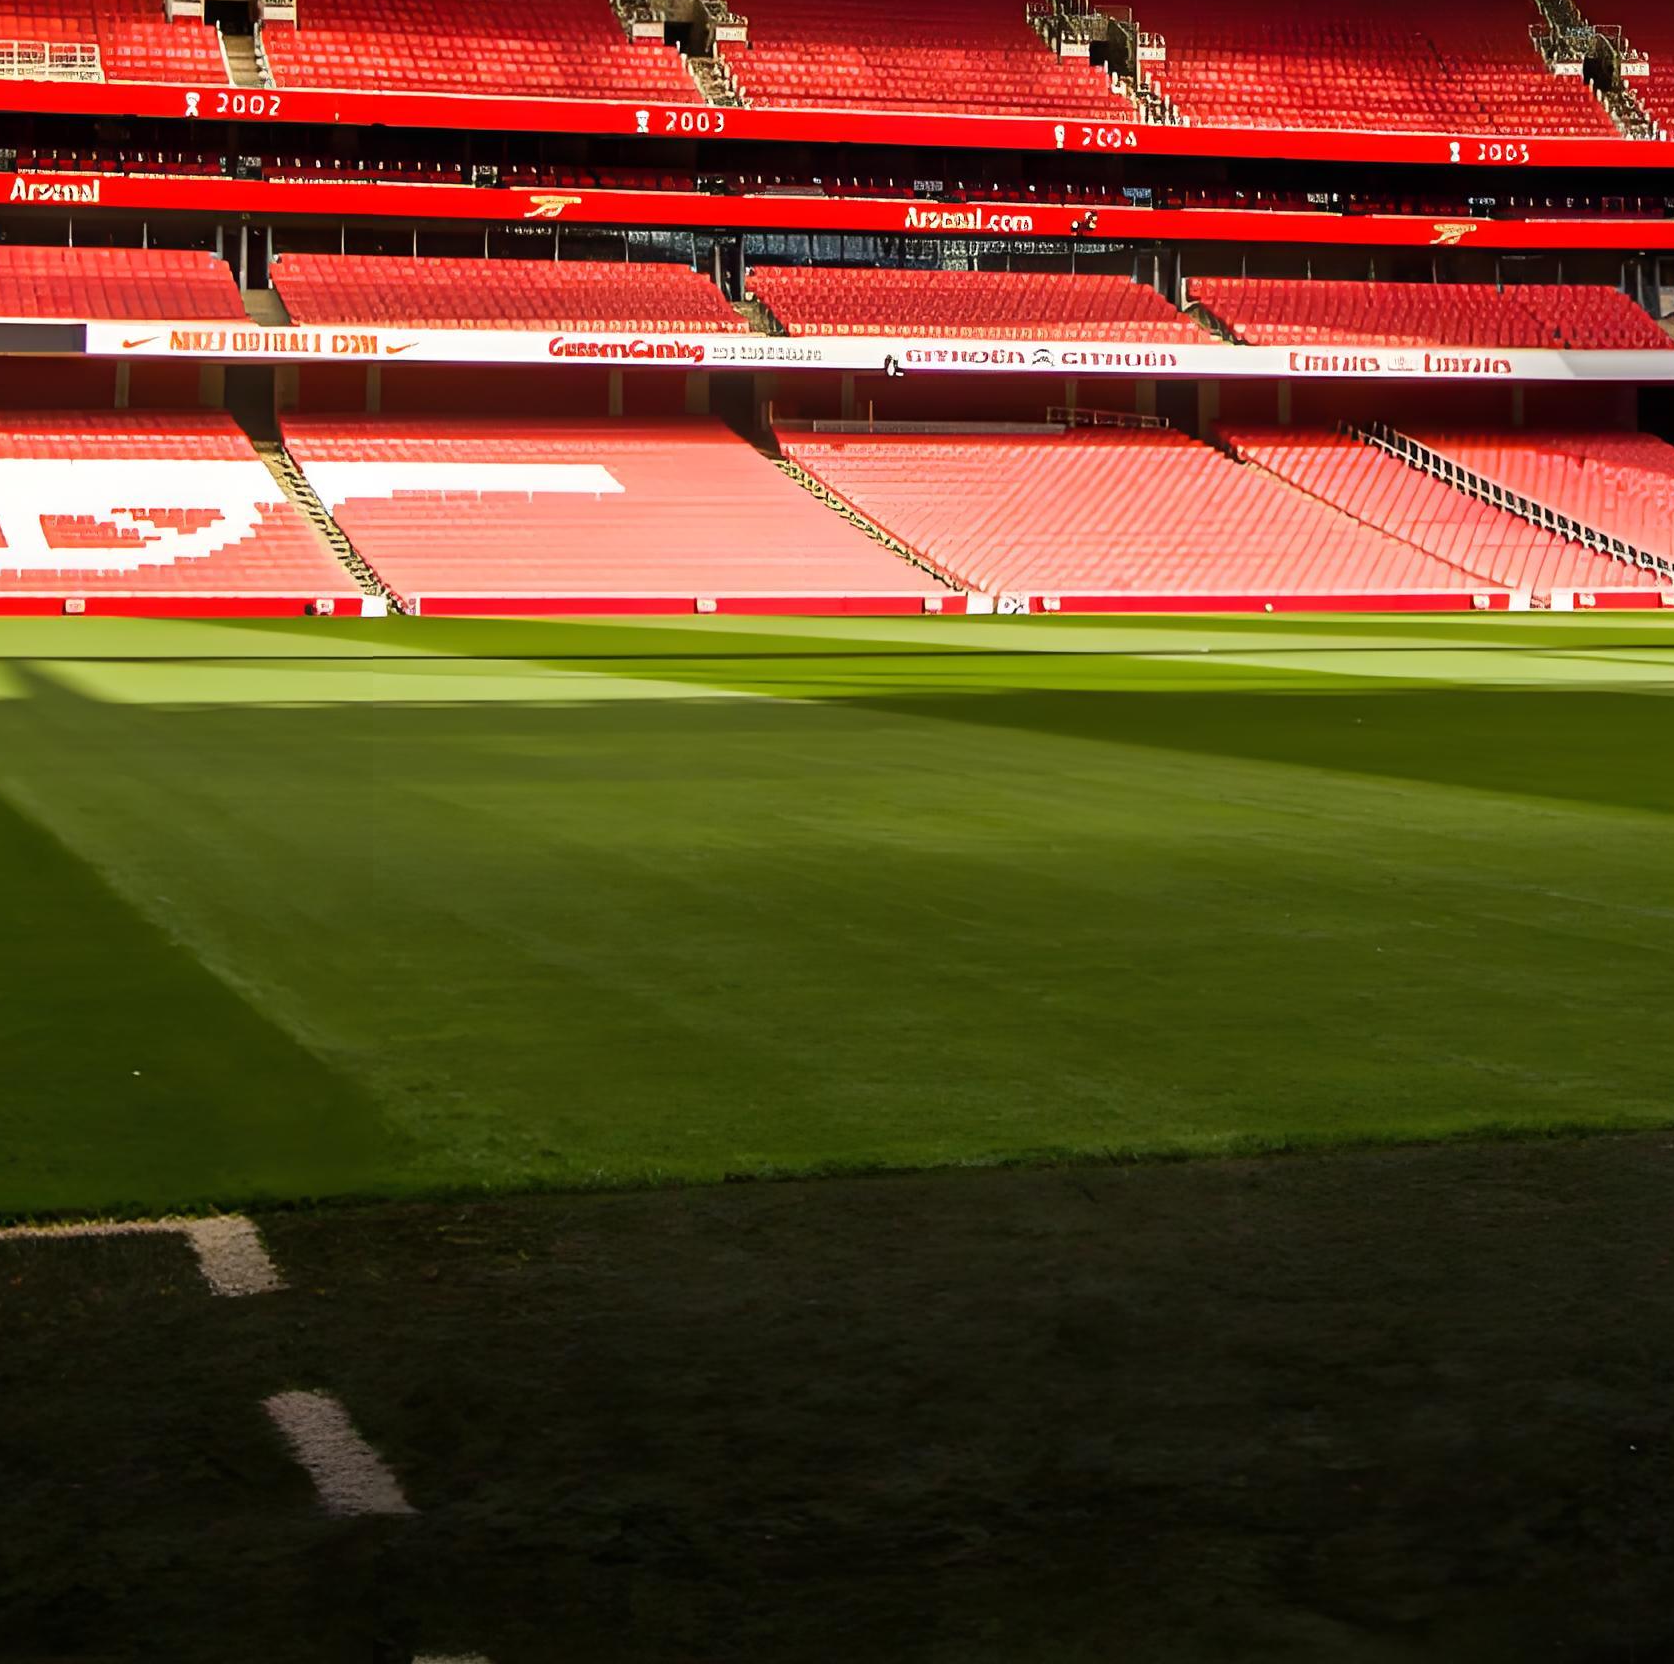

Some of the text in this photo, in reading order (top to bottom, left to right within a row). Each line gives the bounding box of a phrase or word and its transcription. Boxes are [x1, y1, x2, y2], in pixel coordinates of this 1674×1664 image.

[215, 92, 281, 117] 2002
[665, 111, 725, 133] 2003
[9, 177, 100, 204] Arsenal
[904, 207, 1033, 233] Arsenal.com
